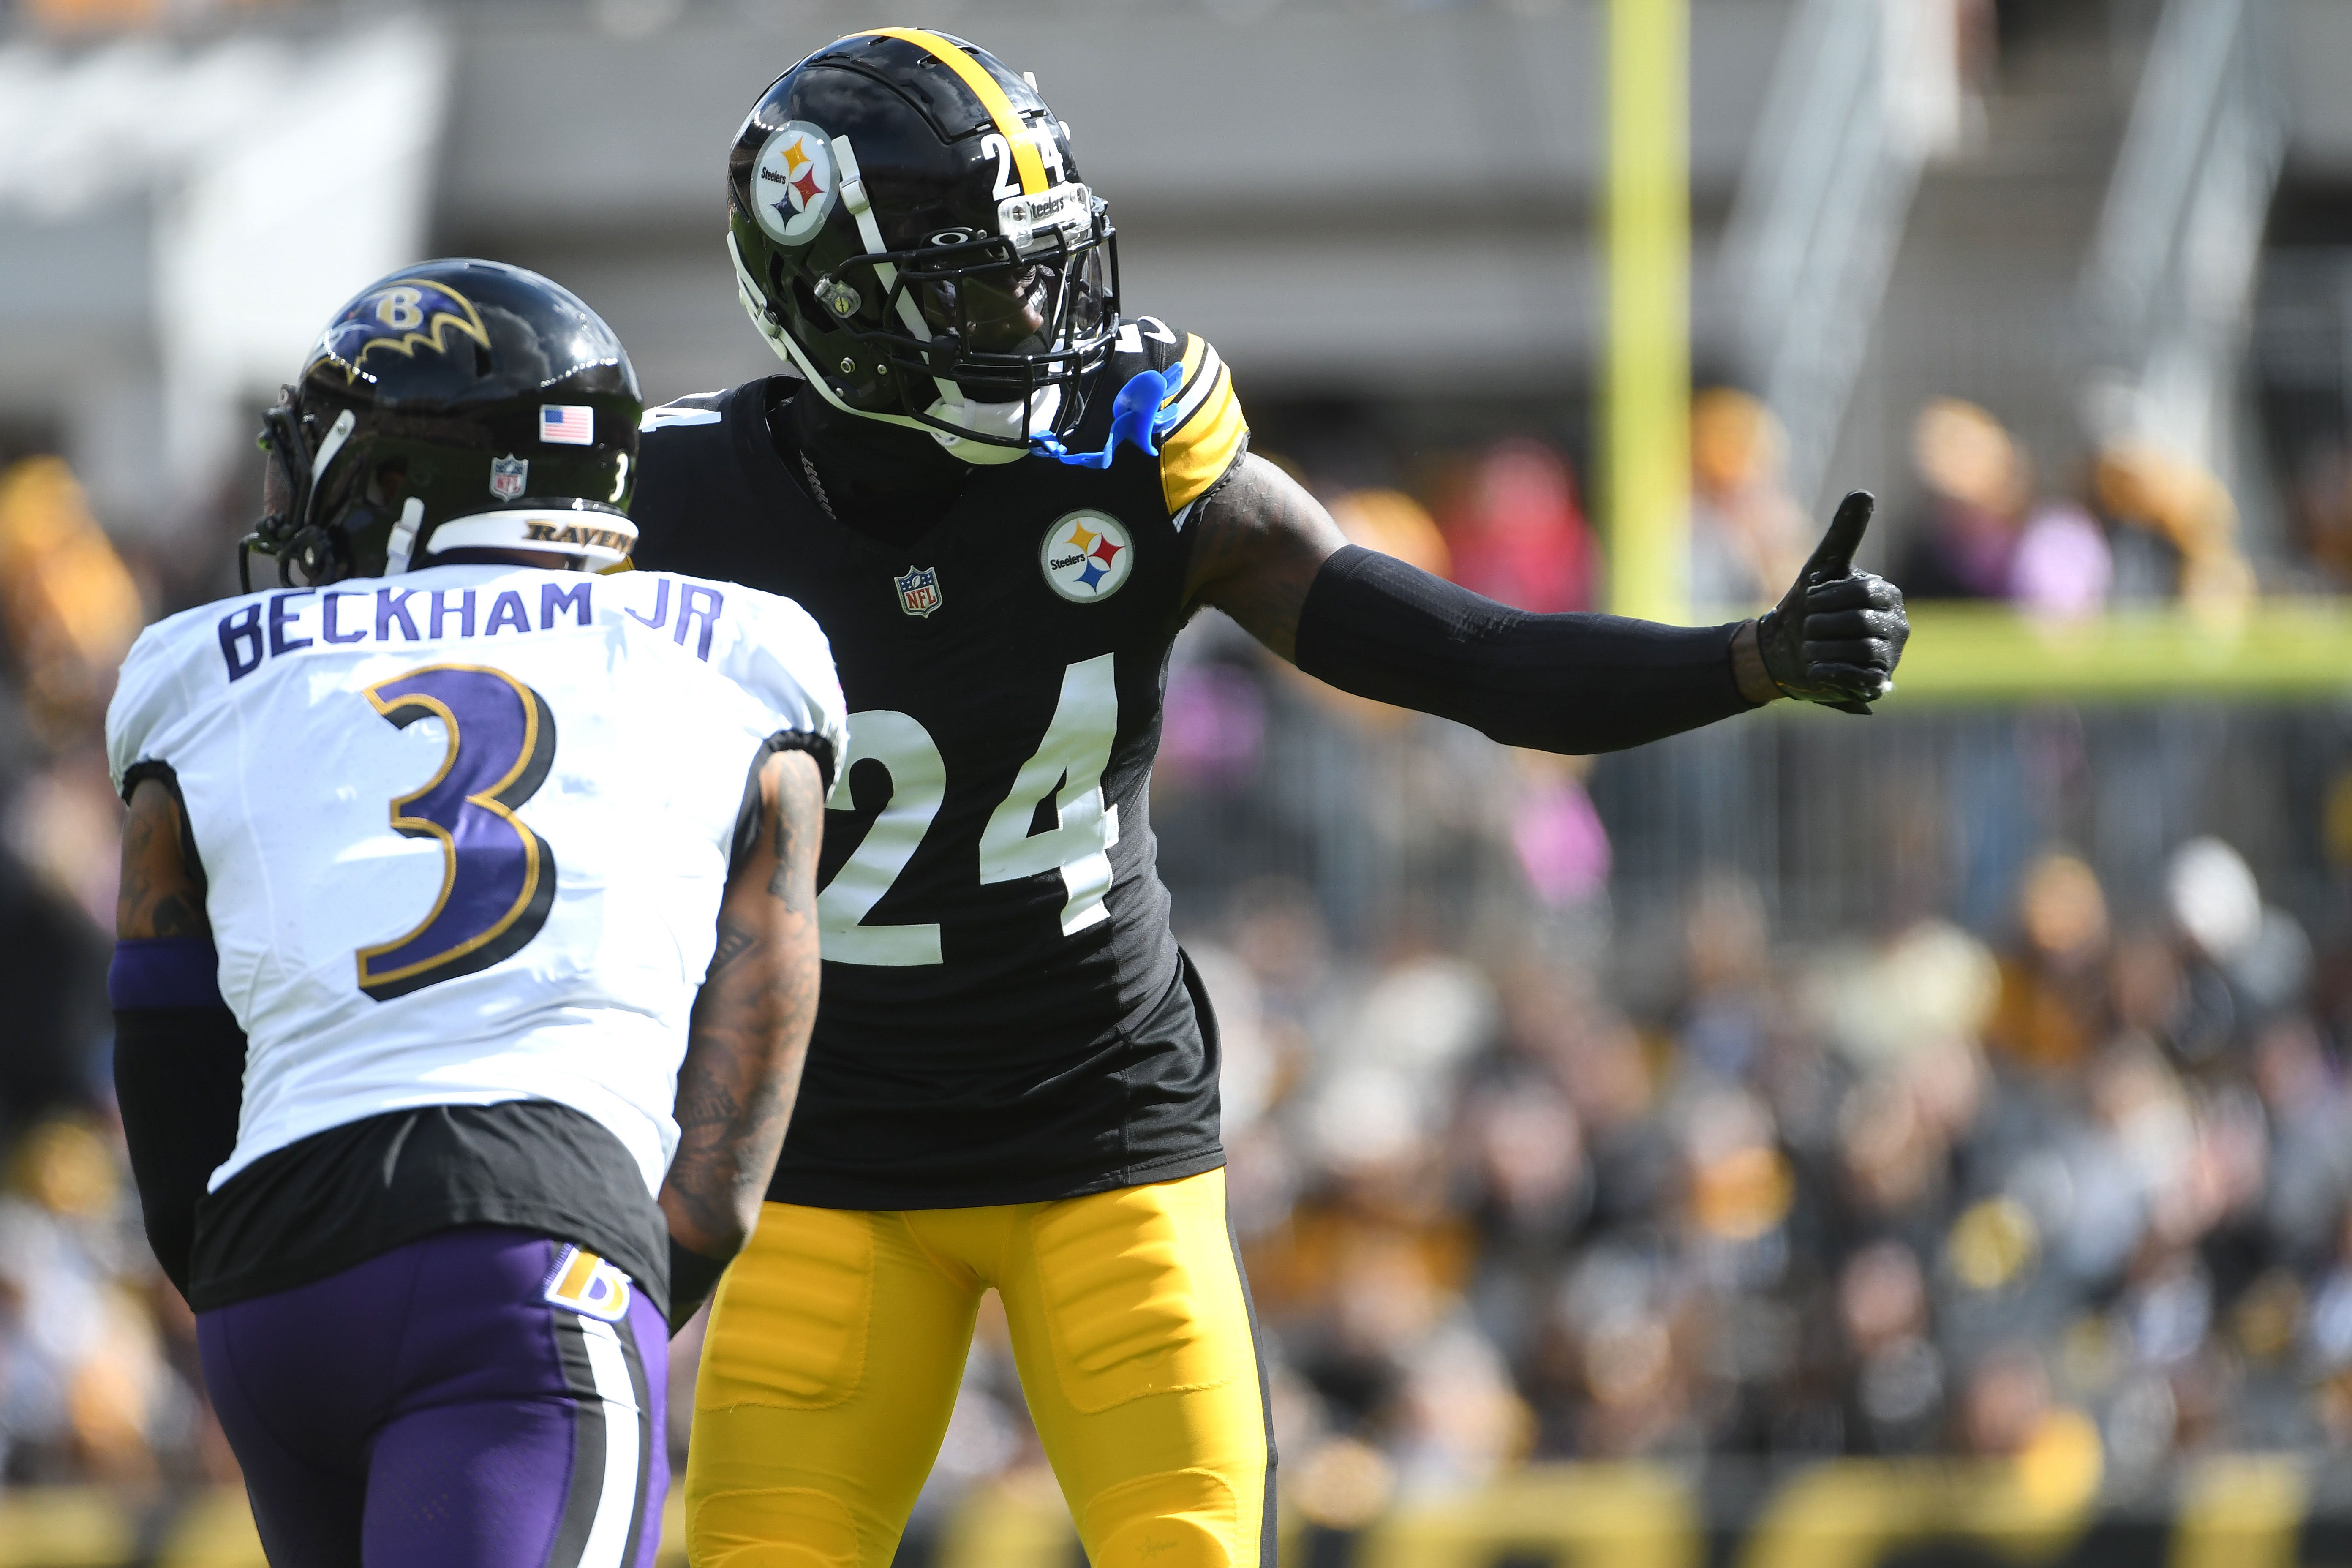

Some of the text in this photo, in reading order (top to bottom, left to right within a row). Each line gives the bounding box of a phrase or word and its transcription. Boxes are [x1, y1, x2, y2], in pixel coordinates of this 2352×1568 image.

[761, 166, 786, 185] Steelers
[1050, 553, 1086, 571] Steelers
[906, 587, 936, 609] NFL
[218, 578, 724, 683] BECKHAM JR
[356, 662, 557, 1002] 3
[816, 652, 1119, 966] 24
